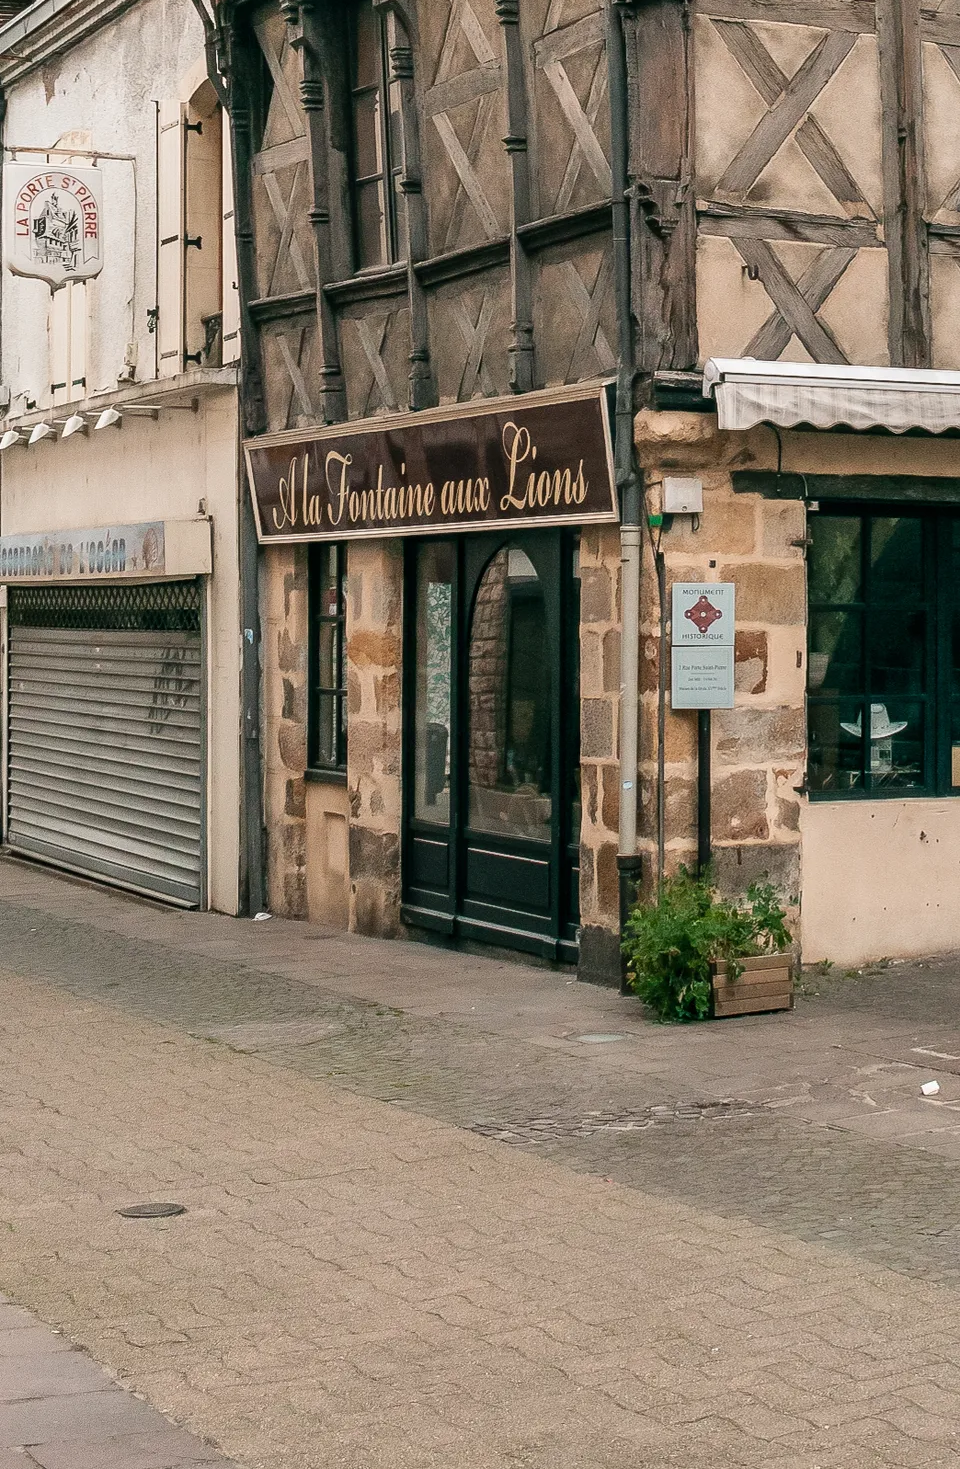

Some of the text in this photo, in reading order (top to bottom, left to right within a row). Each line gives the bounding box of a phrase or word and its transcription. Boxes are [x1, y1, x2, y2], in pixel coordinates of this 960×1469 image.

[17, 175, 55, 212] PORTE
[16, 218, 29, 236] LA
[75, 187, 97, 239] PIERRE
[272, 421, 589, 530] A la Fontaine aux Lions
[682, 633, 724, 641] HISTORIQUE
